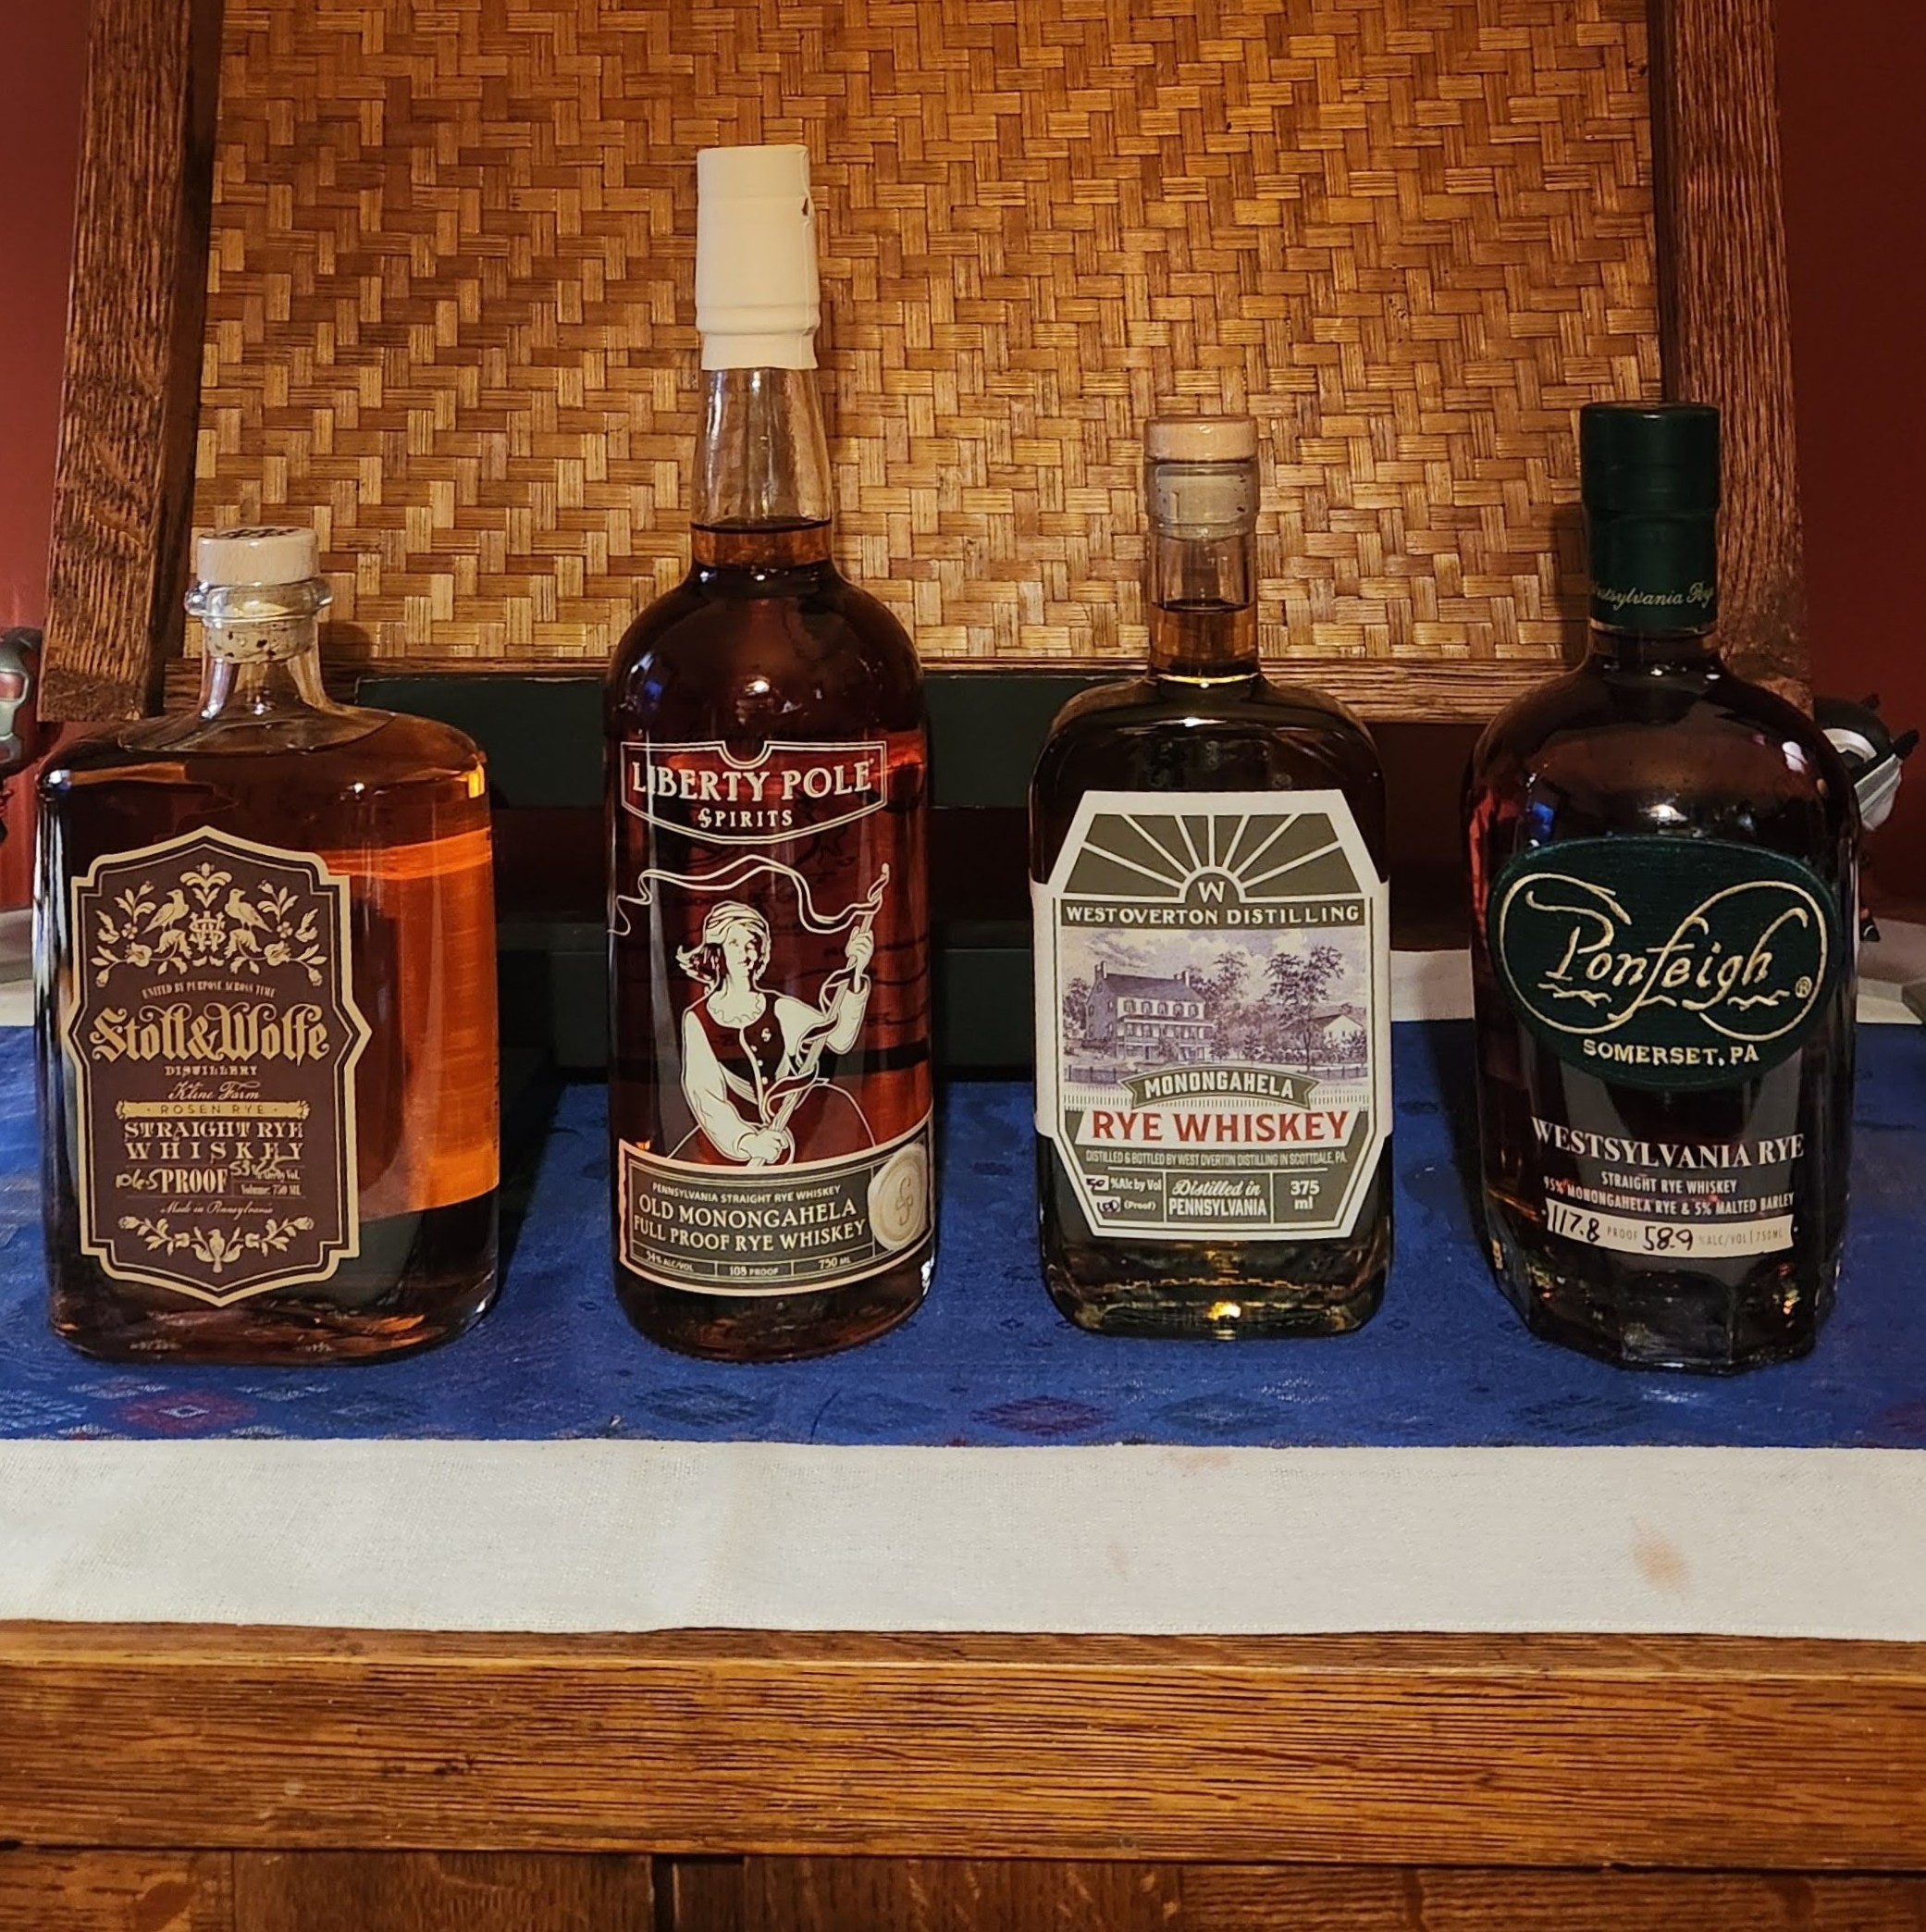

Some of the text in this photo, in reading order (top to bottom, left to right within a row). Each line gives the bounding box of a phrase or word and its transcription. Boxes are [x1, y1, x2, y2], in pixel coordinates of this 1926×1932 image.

[632, 761, 873, 802] LIBERTY POLE
[698, 807, 794, 828] SPIRITS
[1198, 881, 1225, 904] W
[1226, 906, 1360, 924] DISTILLING
[1515, 877, 1815, 1025] Ponfeigh
[1583, 1038, 1760, 1067] SOMERSET, PA
[165, 1065, 258, 1077] DISTILLERY
[218, 1081, 261, 1101] Farm
[1143, 1070, 1294, 1100] MONONGAHELA
[160, 1104, 265, 1116] ROSEN RYE
[124, 1121, 304, 1141] STRAIGHT RYE
[1092, 1110, 1351, 1143] RYE WHISKEY
[124, 1141, 305, 1161] WHISKEY
[1531, 1116, 1805, 1169] WESTSYLVANIA RYE
[1085, 1149, 1124, 1164] DISTILLED
[1131, 1151, 1165, 1165] BOTTLED
[1166, 1153, 1177, 1165] BY
[1178, 1153, 1200, 1166] WEST
[1200, 1153, 1236, 1166] OVERTON
[1237, 1153, 1278, 1167] DISTILLING
[1279, 1153, 1289, 1166] IN
[161, 1168, 228, 1195] PROOF
[1133, 1178, 1146, 1193] by
[1147, 1178, 1162, 1191] Vol
[1171, 1178, 1262, 1196] Distilled in
[1290, 1179, 1320, 1195] 375
[1600, 1171, 1738, 1195] STRAIGHT RYE WHISKEY
[652, 1183, 842, 1204] PENNSYLVANIA STRAIGHT RYE WHISKEY
[1294, 1195, 1314, 1210] ml
[1543, 1176, 1795, 1216] 95% MONONGAHELA RYE & 5% MALTED BARLEY
[159, 1201, 274, 1221] Made in Pennsylvania
[638, 1195, 858, 1230] OLD MONONGAHELA
[1123, 1200, 1157, 1211] (Proof)
[1168, 1197, 1267, 1217] PENNSYLVANIA
[633, 1214, 867, 1253] FULL PROOF RYE WHISKEY
[1607, 1225, 1638, 1240] PROOF
[663, 1258, 695, 1272] ALC/VOL
[748, 1267, 779, 1277] PROOF
[818, 1257, 838, 1269] 750
